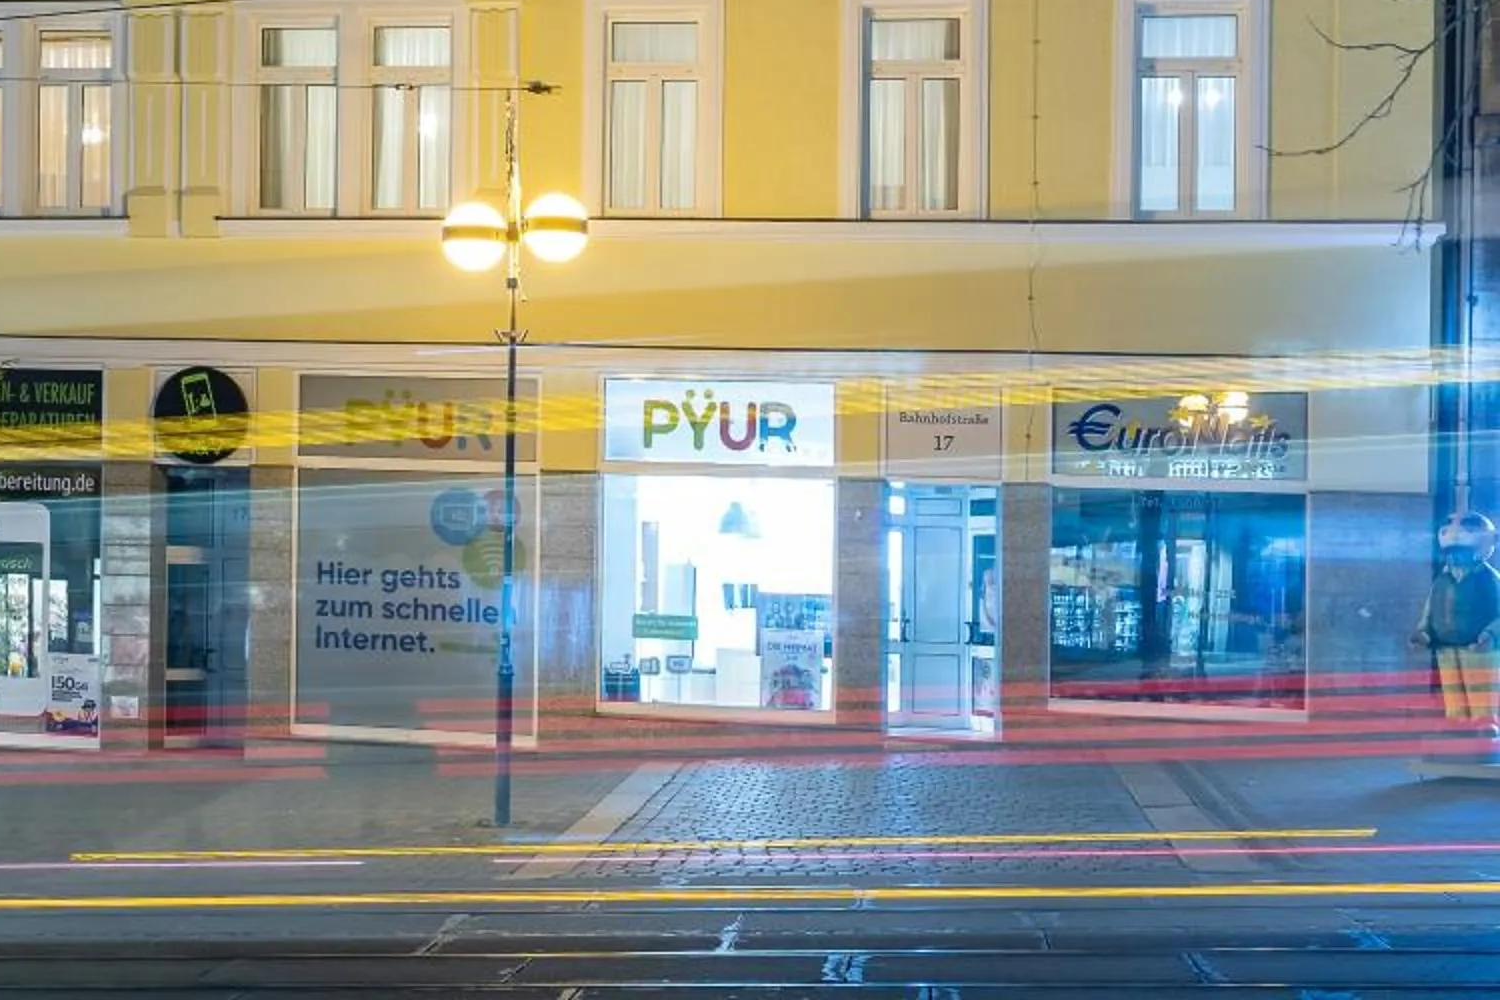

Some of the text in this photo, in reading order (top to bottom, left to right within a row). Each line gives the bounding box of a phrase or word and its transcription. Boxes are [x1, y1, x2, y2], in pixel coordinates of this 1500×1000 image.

[19, 381, 31, 403] &
[34, 382, 96, 404] VERKAUF
[899, 411, 989, 424] Bahnhofstraße
[933, 435, 955, 451] 17
[317, 561, 461, 593] Hier gehts
[316, 598, 516, 625] zum schnelle
[316, 624, 436, 653] Internet.
